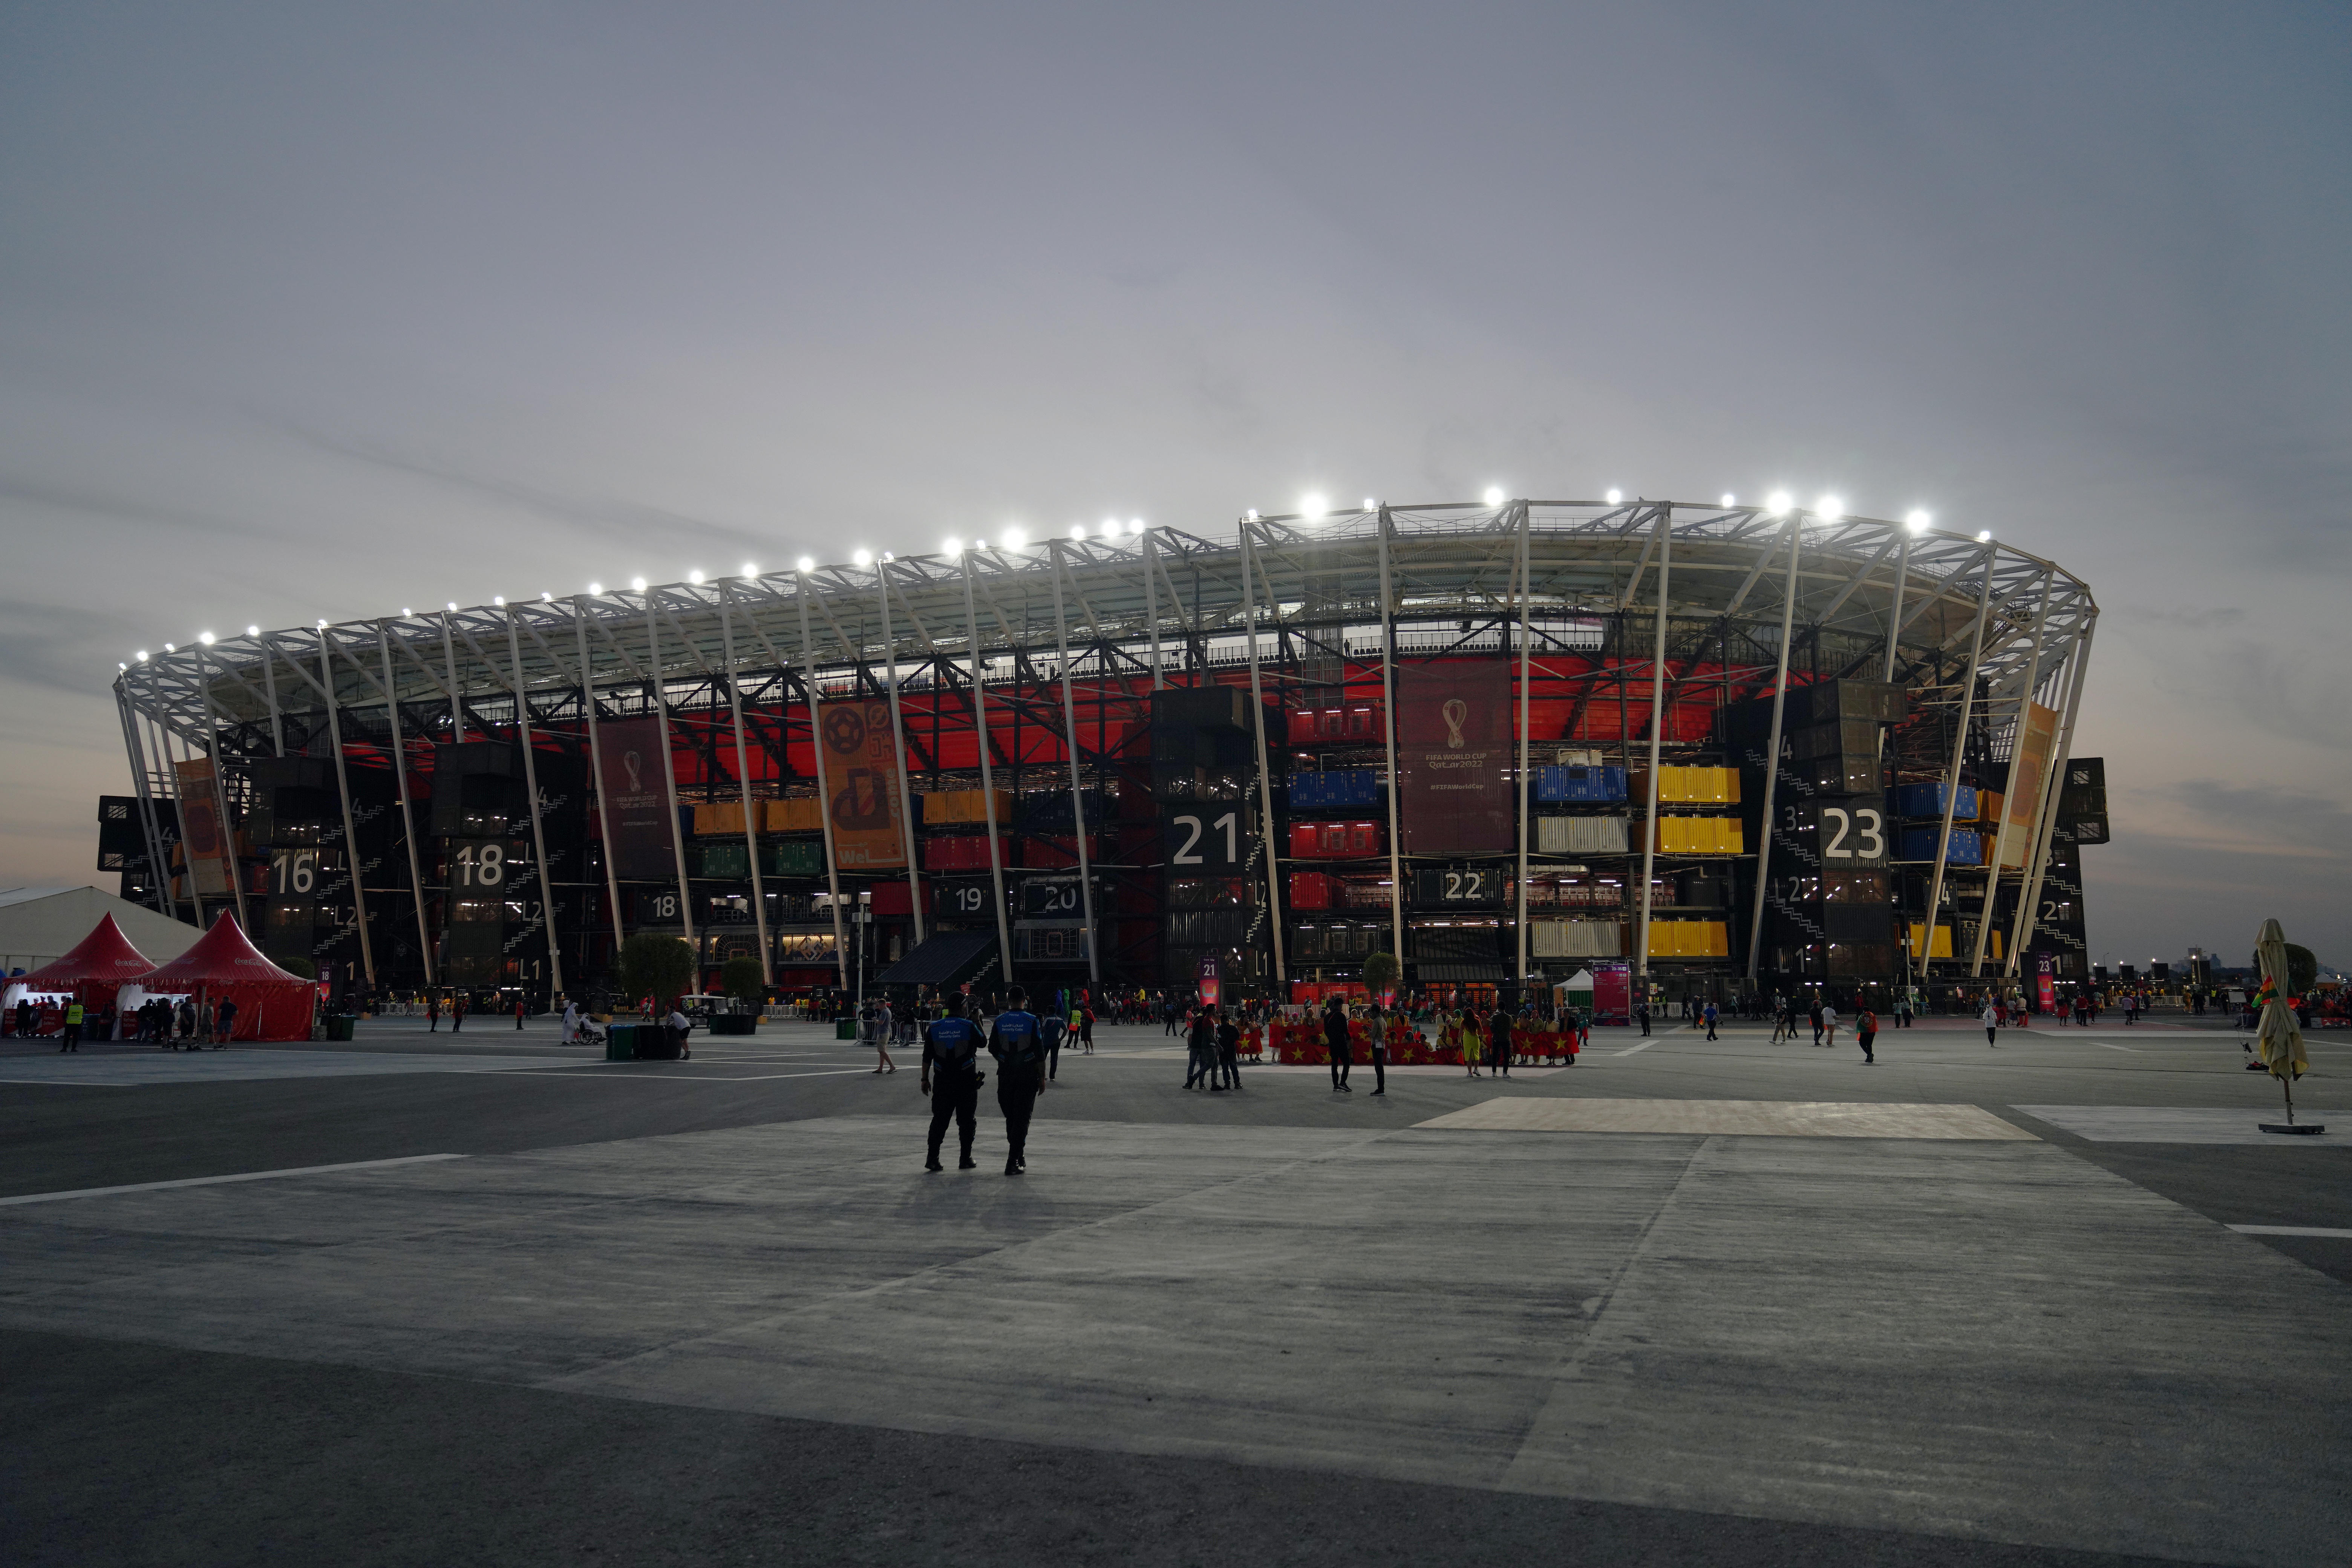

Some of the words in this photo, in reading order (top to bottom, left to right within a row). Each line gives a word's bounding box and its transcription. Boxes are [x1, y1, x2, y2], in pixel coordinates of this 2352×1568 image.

[1173, 812, 1236, 864] 21
[1824, 808, 1883, 859] 23
[273, 854, 314, 894] 16
[456, 844, 503, 886] 18
[1046, 886, 1076, 909] 20
[1254, 879, 1266, 906] L2
[1445, 873, 1482, 899] 22
[1775, 876, 1801, 904] L2
[522, 900, 542, 922] L2
[652, 896, 675, 917] 18
[956, 888, 982, 911] 19
[334, 905, 357, 925] L2
[115, 959, 142, 967] Coca-Cola
[234, 957, 262, 966] Coca-Cola
[519, 959, 540, 980] L1
[1204, 964, 1214, 976] 21
[1256, 950, 1268, 976] L1
[1778, 948, 1805, 974] L1
[2038, 960, 2050, 972] 23
[322, 971, 329, 980] 18
